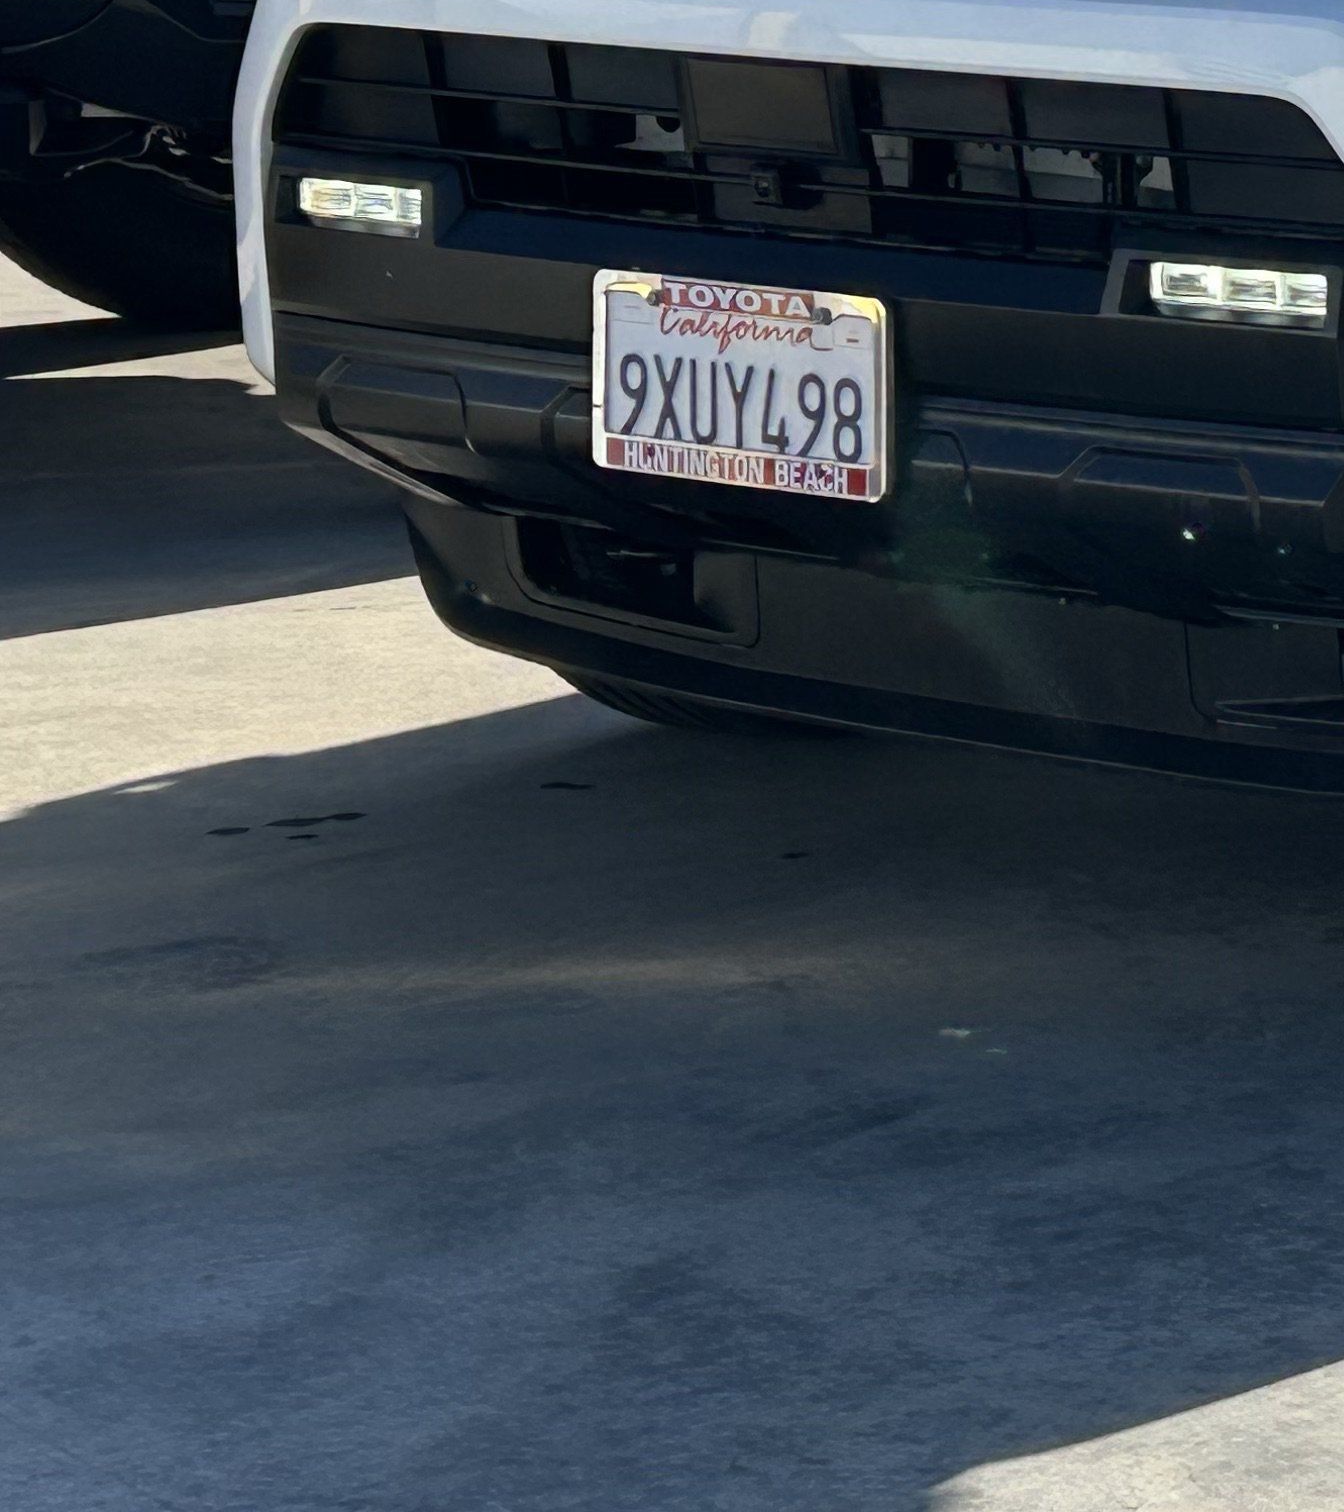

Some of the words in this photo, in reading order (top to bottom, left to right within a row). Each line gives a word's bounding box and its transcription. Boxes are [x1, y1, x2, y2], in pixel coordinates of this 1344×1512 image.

[663, 282, 807, 317] TOYOTA
[660, 307, 833, 354] California
[619, 353, 863, 464] 9XUY498
[624, 441, 765, 484] HUNTINGTON
[774, 460, 849, 493] BEACH
